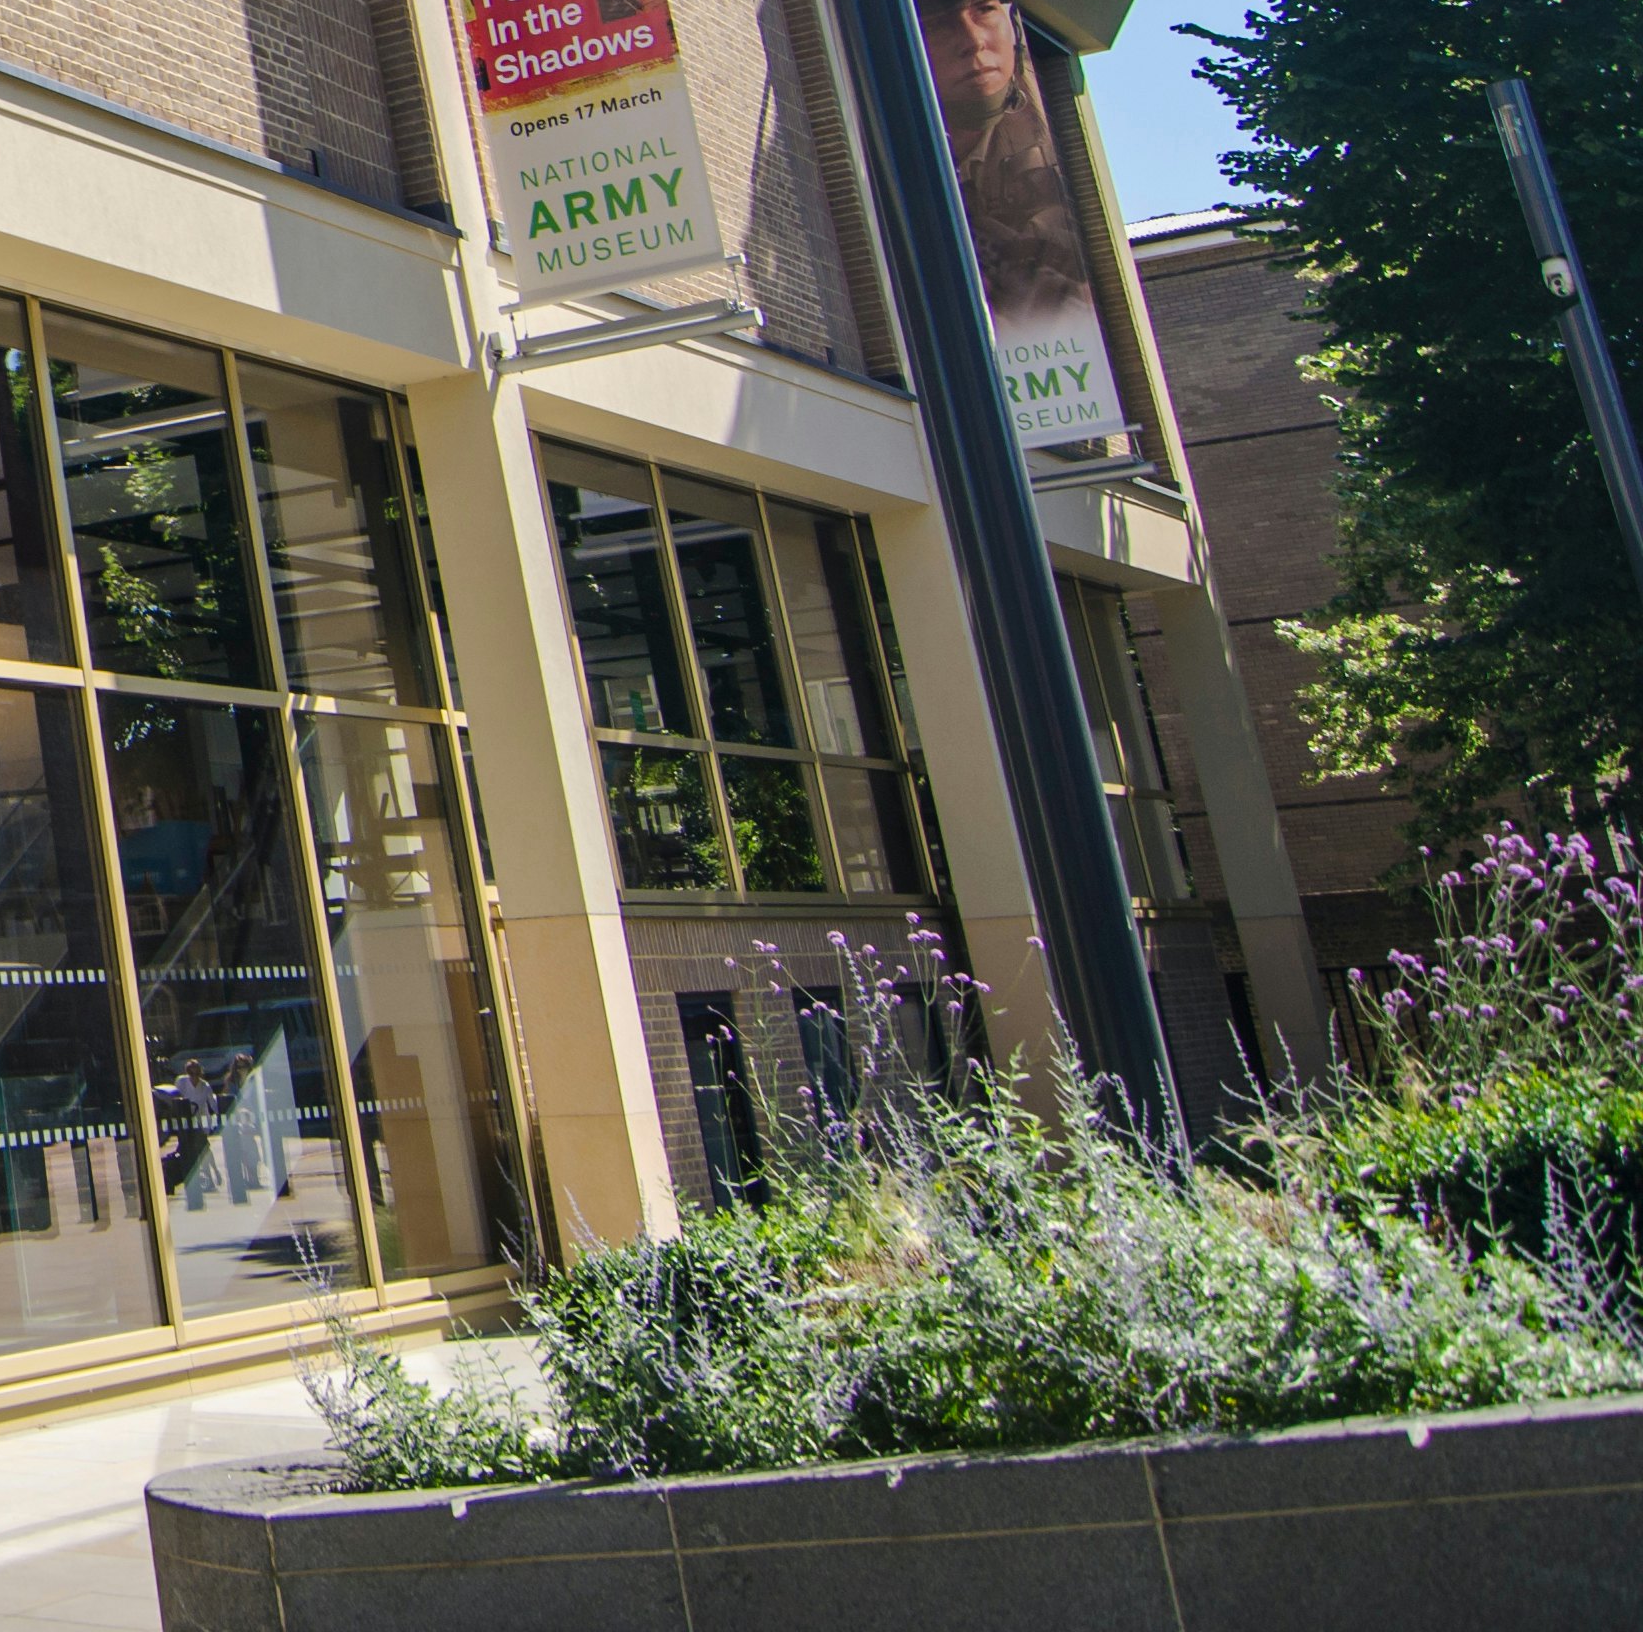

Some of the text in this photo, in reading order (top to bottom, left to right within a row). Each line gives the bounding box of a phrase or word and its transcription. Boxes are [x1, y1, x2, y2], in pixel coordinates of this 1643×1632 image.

[486, 2, 583, 47] In the
[494, 24, 654, 85] Shadows
[509, 87, 663, 139] Opens 17 March
[519, 136, 677, 191] NATIONAL
[528, 167, 684, 240] ARMY
[536, 218, 695, 275] MUSEUM
[1004, 337, 1085, 365] IONAL
[1004, 361, 1090, 403] RMY
[1016, 401, 1099, 431] SEUM
